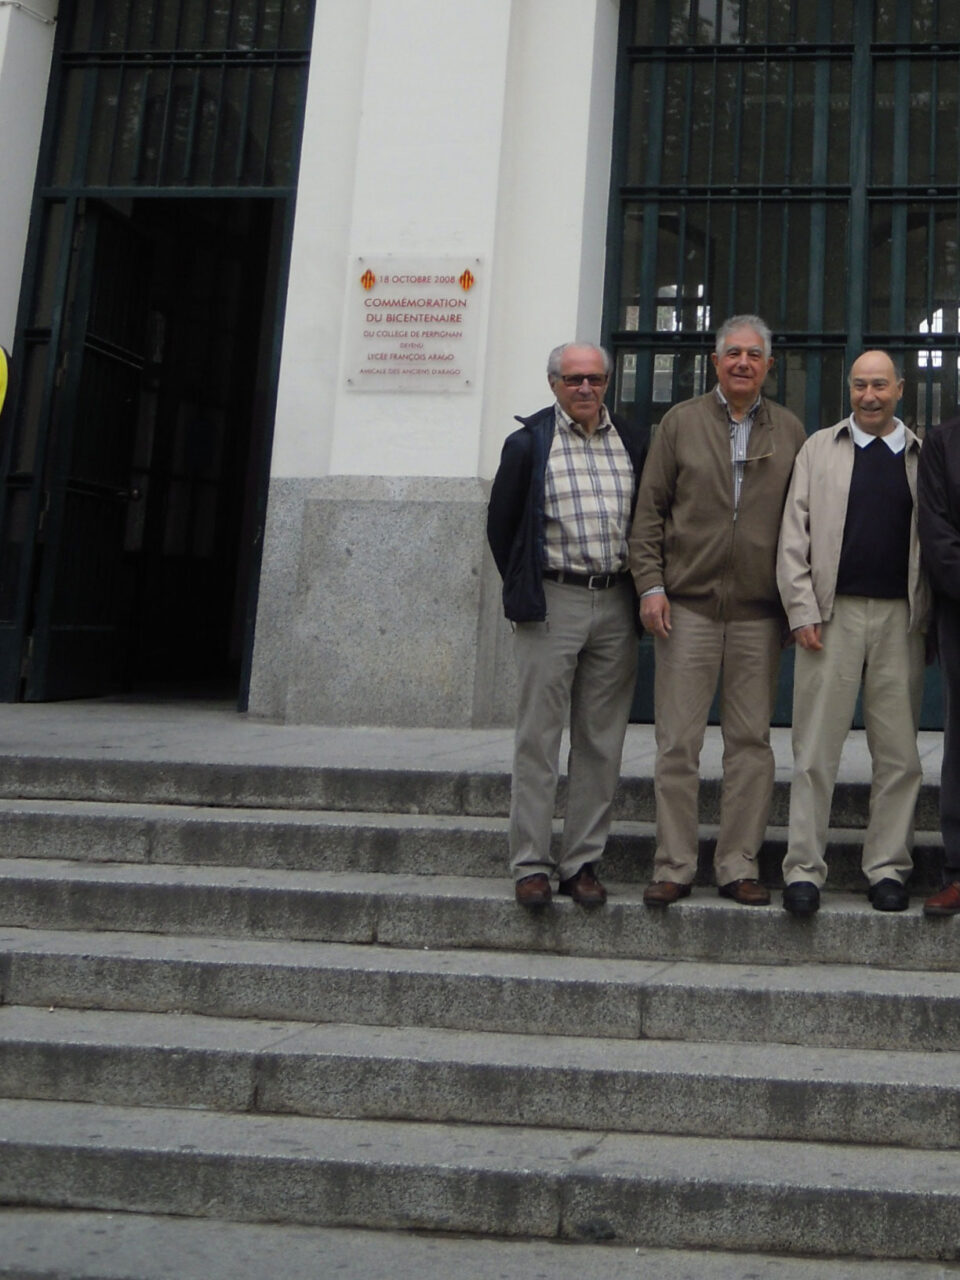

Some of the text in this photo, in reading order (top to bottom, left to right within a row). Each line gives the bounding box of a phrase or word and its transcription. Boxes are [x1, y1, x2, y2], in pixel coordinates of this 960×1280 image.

[380, 275, 455, 284] 18 OCTOBRE 2008
[364, 297, 467, 308] COMMÉMORATION
[366, 313, 462, 323] DU BICENTENAIRE
[410, 330, 420, 338] DE
